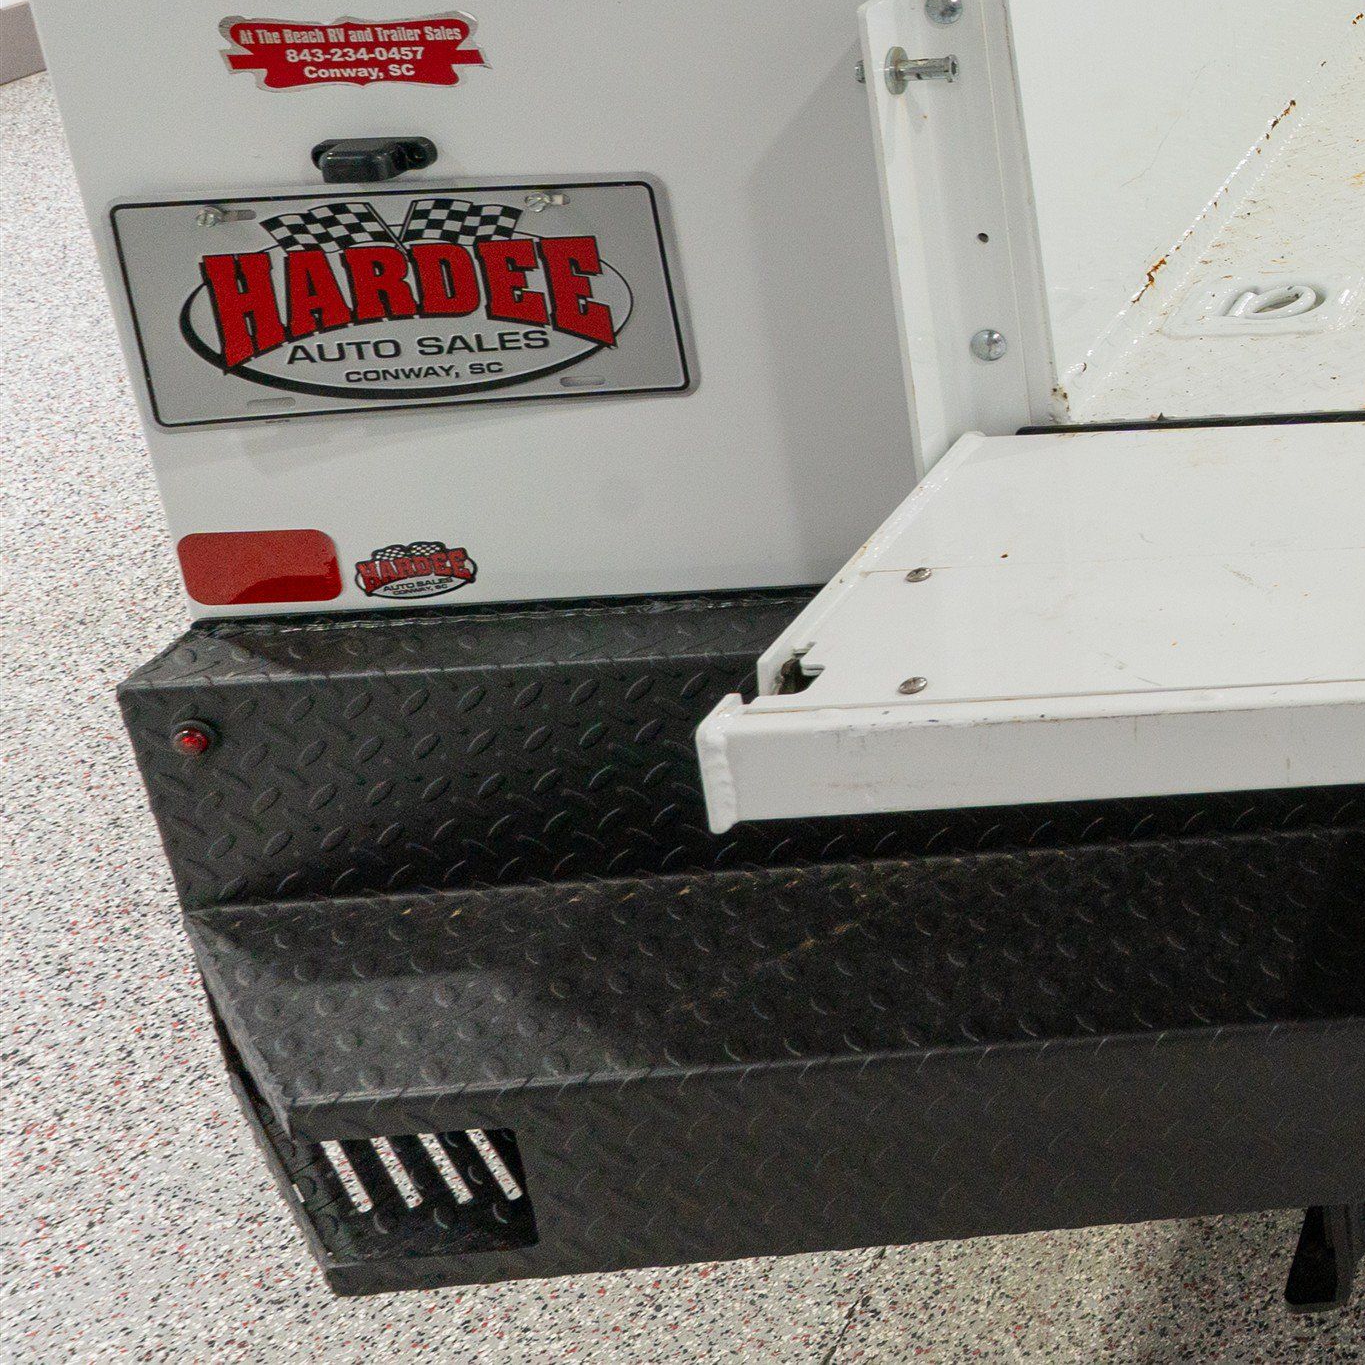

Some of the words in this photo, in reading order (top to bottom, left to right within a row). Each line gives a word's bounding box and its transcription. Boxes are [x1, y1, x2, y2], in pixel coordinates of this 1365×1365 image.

[239, 29, 254, 45] At
[257, 28, 282, 45] The
[283, 27, 325, 44] Beach
[326, 26, 346, 43] RV
[349, 26, 373, 43] and
[375, 26, 421, 43] Trailer
[424, 25, 462, 41] Sales
[285, 46, 425, 64] 843-234-0457
[303, 65, 384, 80] Conway,
[388, 64, 416, 77] SC
[199, 235, 618, 376] HARDEE
[286, 338, 402, 366] AUTO
[417, 329, 551, 356] SALES
[344, 364, 459, 384] CONWAY,
[468, 361, 504, 376] SC
[356, 547, 474, 595] HARDEE
[383, 582, 415, 592] AUTO
[416, 577, 453, 587] SALES
